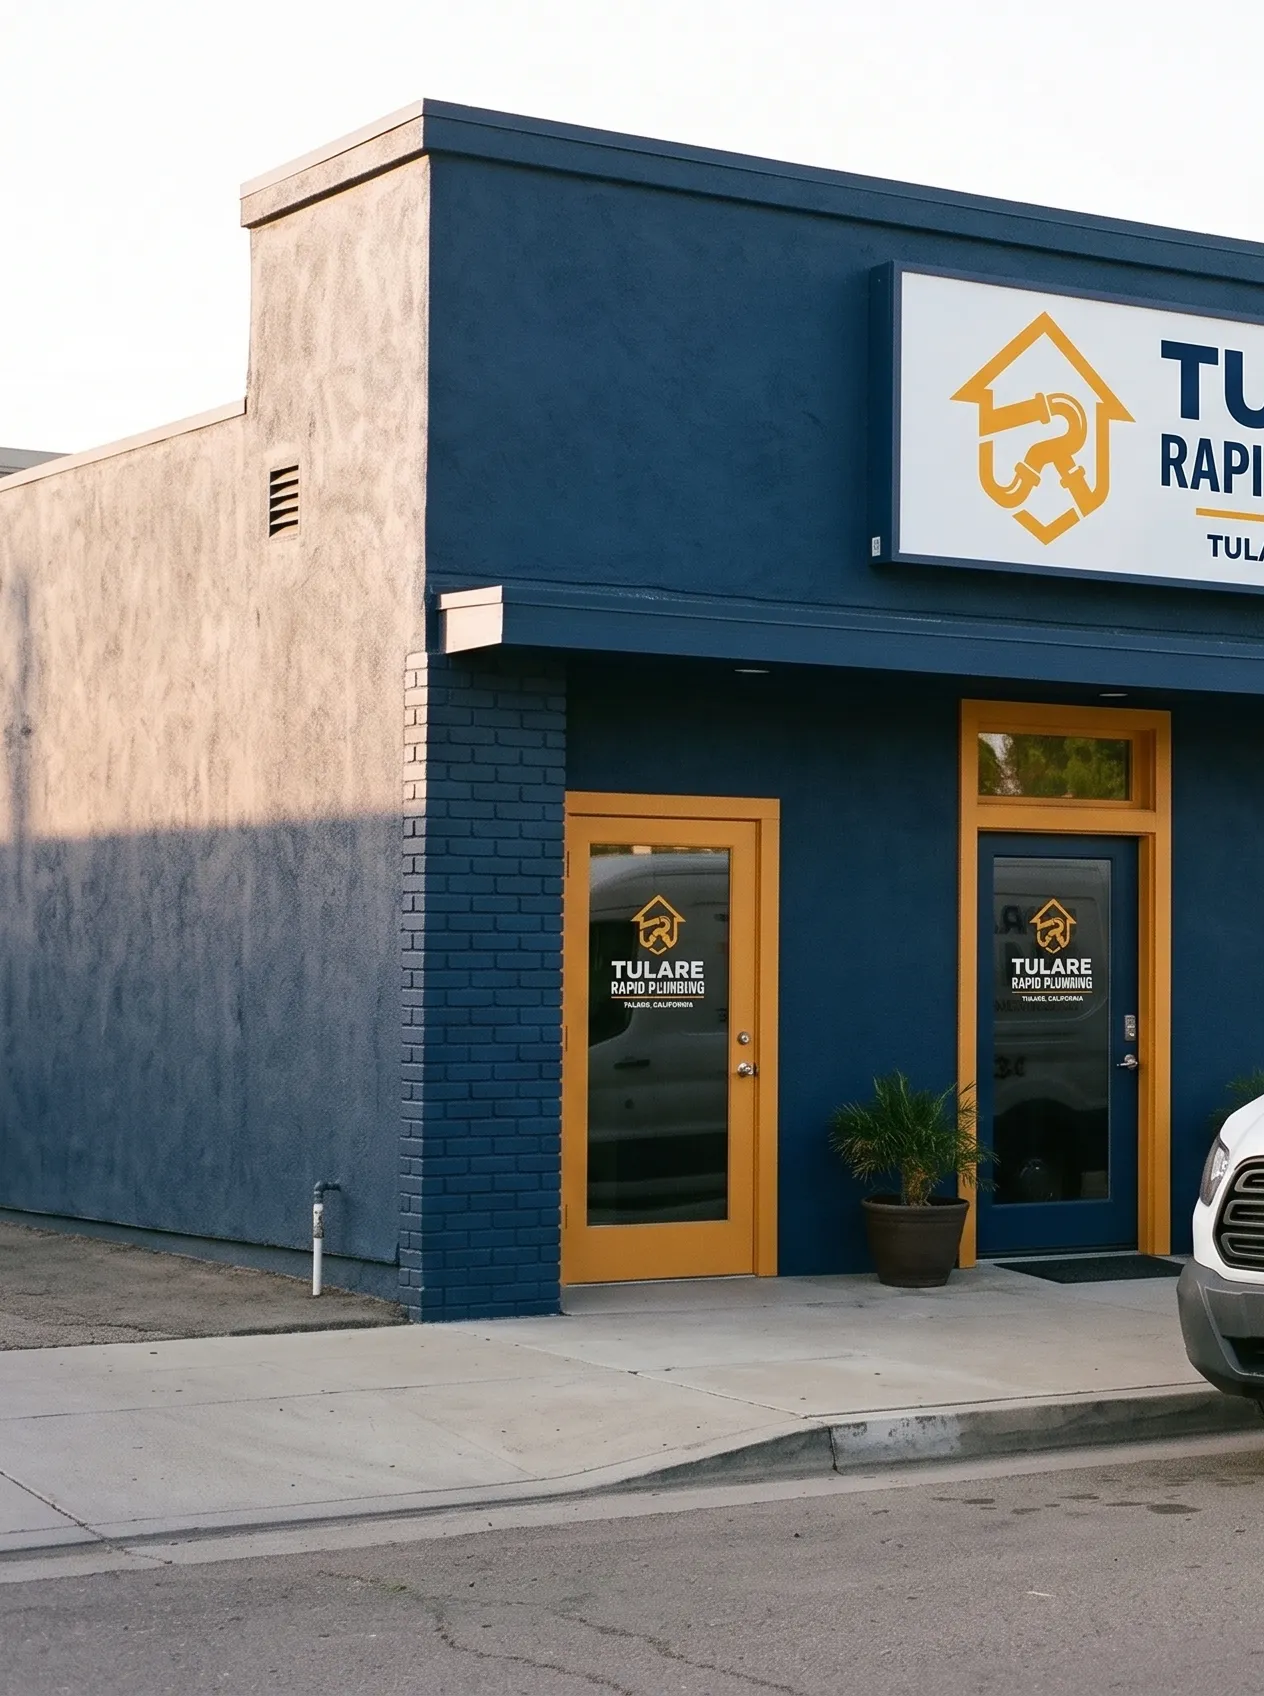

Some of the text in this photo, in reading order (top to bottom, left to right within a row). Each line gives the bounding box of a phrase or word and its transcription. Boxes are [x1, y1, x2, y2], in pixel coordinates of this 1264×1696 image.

[611, 960, 705, 979] TULARE
[1011, 957, 1093, 975] TULARE
[610, 981, 646, 995] RAPID
[1011, 976, 1042, 990] RAPID
